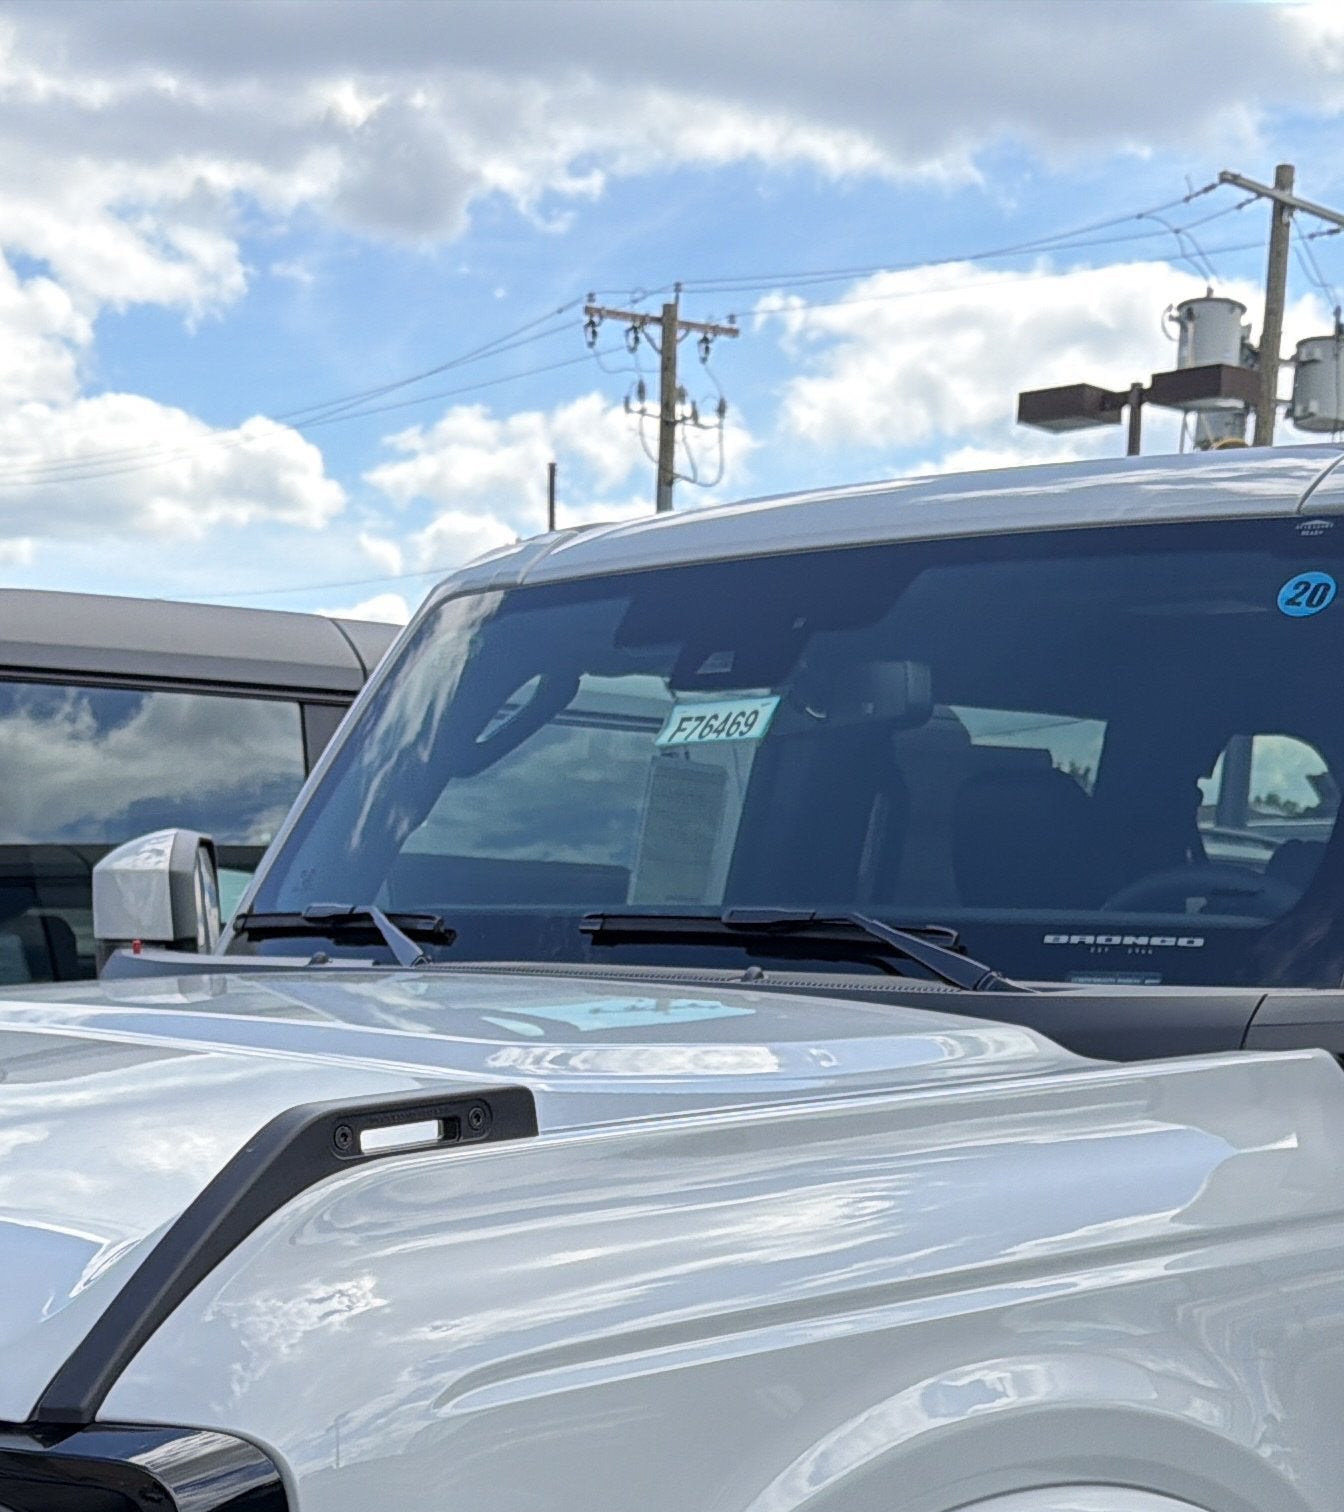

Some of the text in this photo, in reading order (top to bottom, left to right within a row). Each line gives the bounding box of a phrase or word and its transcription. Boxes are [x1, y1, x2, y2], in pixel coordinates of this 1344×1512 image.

[1285, 580, 1331, 608] 20
[668, 709, 760, 743] F76469
[1043, 934, 1205, 947] BRONCO
